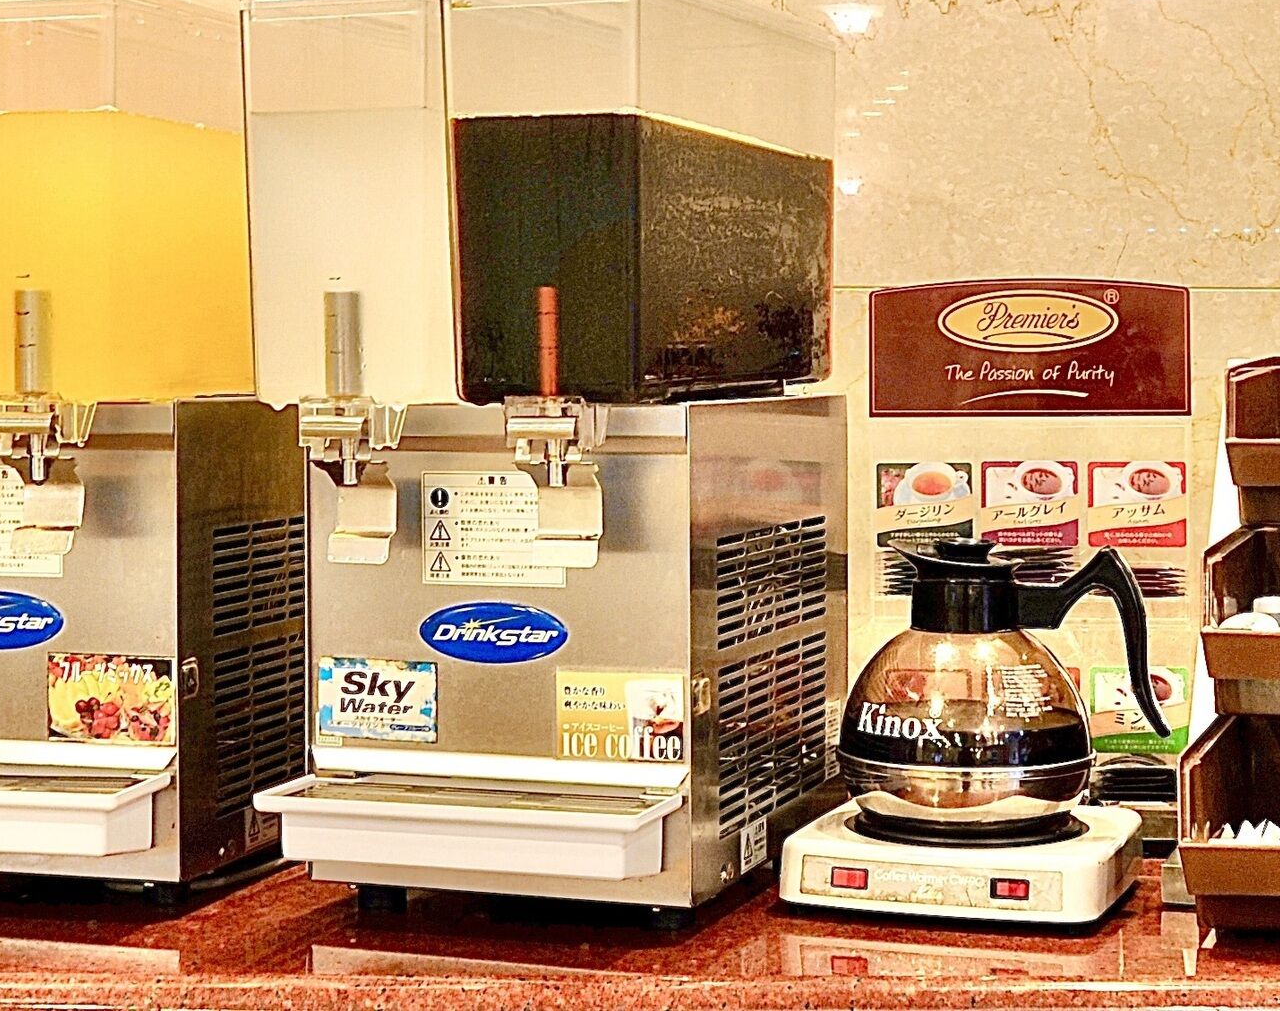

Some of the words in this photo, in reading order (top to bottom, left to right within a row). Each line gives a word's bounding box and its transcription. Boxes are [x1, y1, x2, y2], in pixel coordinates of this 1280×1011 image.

[976, 300, 1081, 332] Premier's
[944, 364, 976, 381] The
[978, 361, 1035, 382] Passion
[1042, 361, 1061, 381] of
[1066, 360, 1116, 387] Purity
[894, 504, 955, 522] ダージリン
[992, 501, 1067, 522] アールグレイ
[1112, 503, 1166, 519] アッサム
[432, 624, 559, 647] Drinkstar
[60, 661, 156, 685] フルーツミックス
[340, 671, 416, 704] Sky
[340, 697, 414, 715] Water
[571, 722, 625, 732] アイスコーヒー
[857, 701, 943, 741] Kinox
[562, 723, 598, 758] ice
[605, 725, 681, 761] coffee
